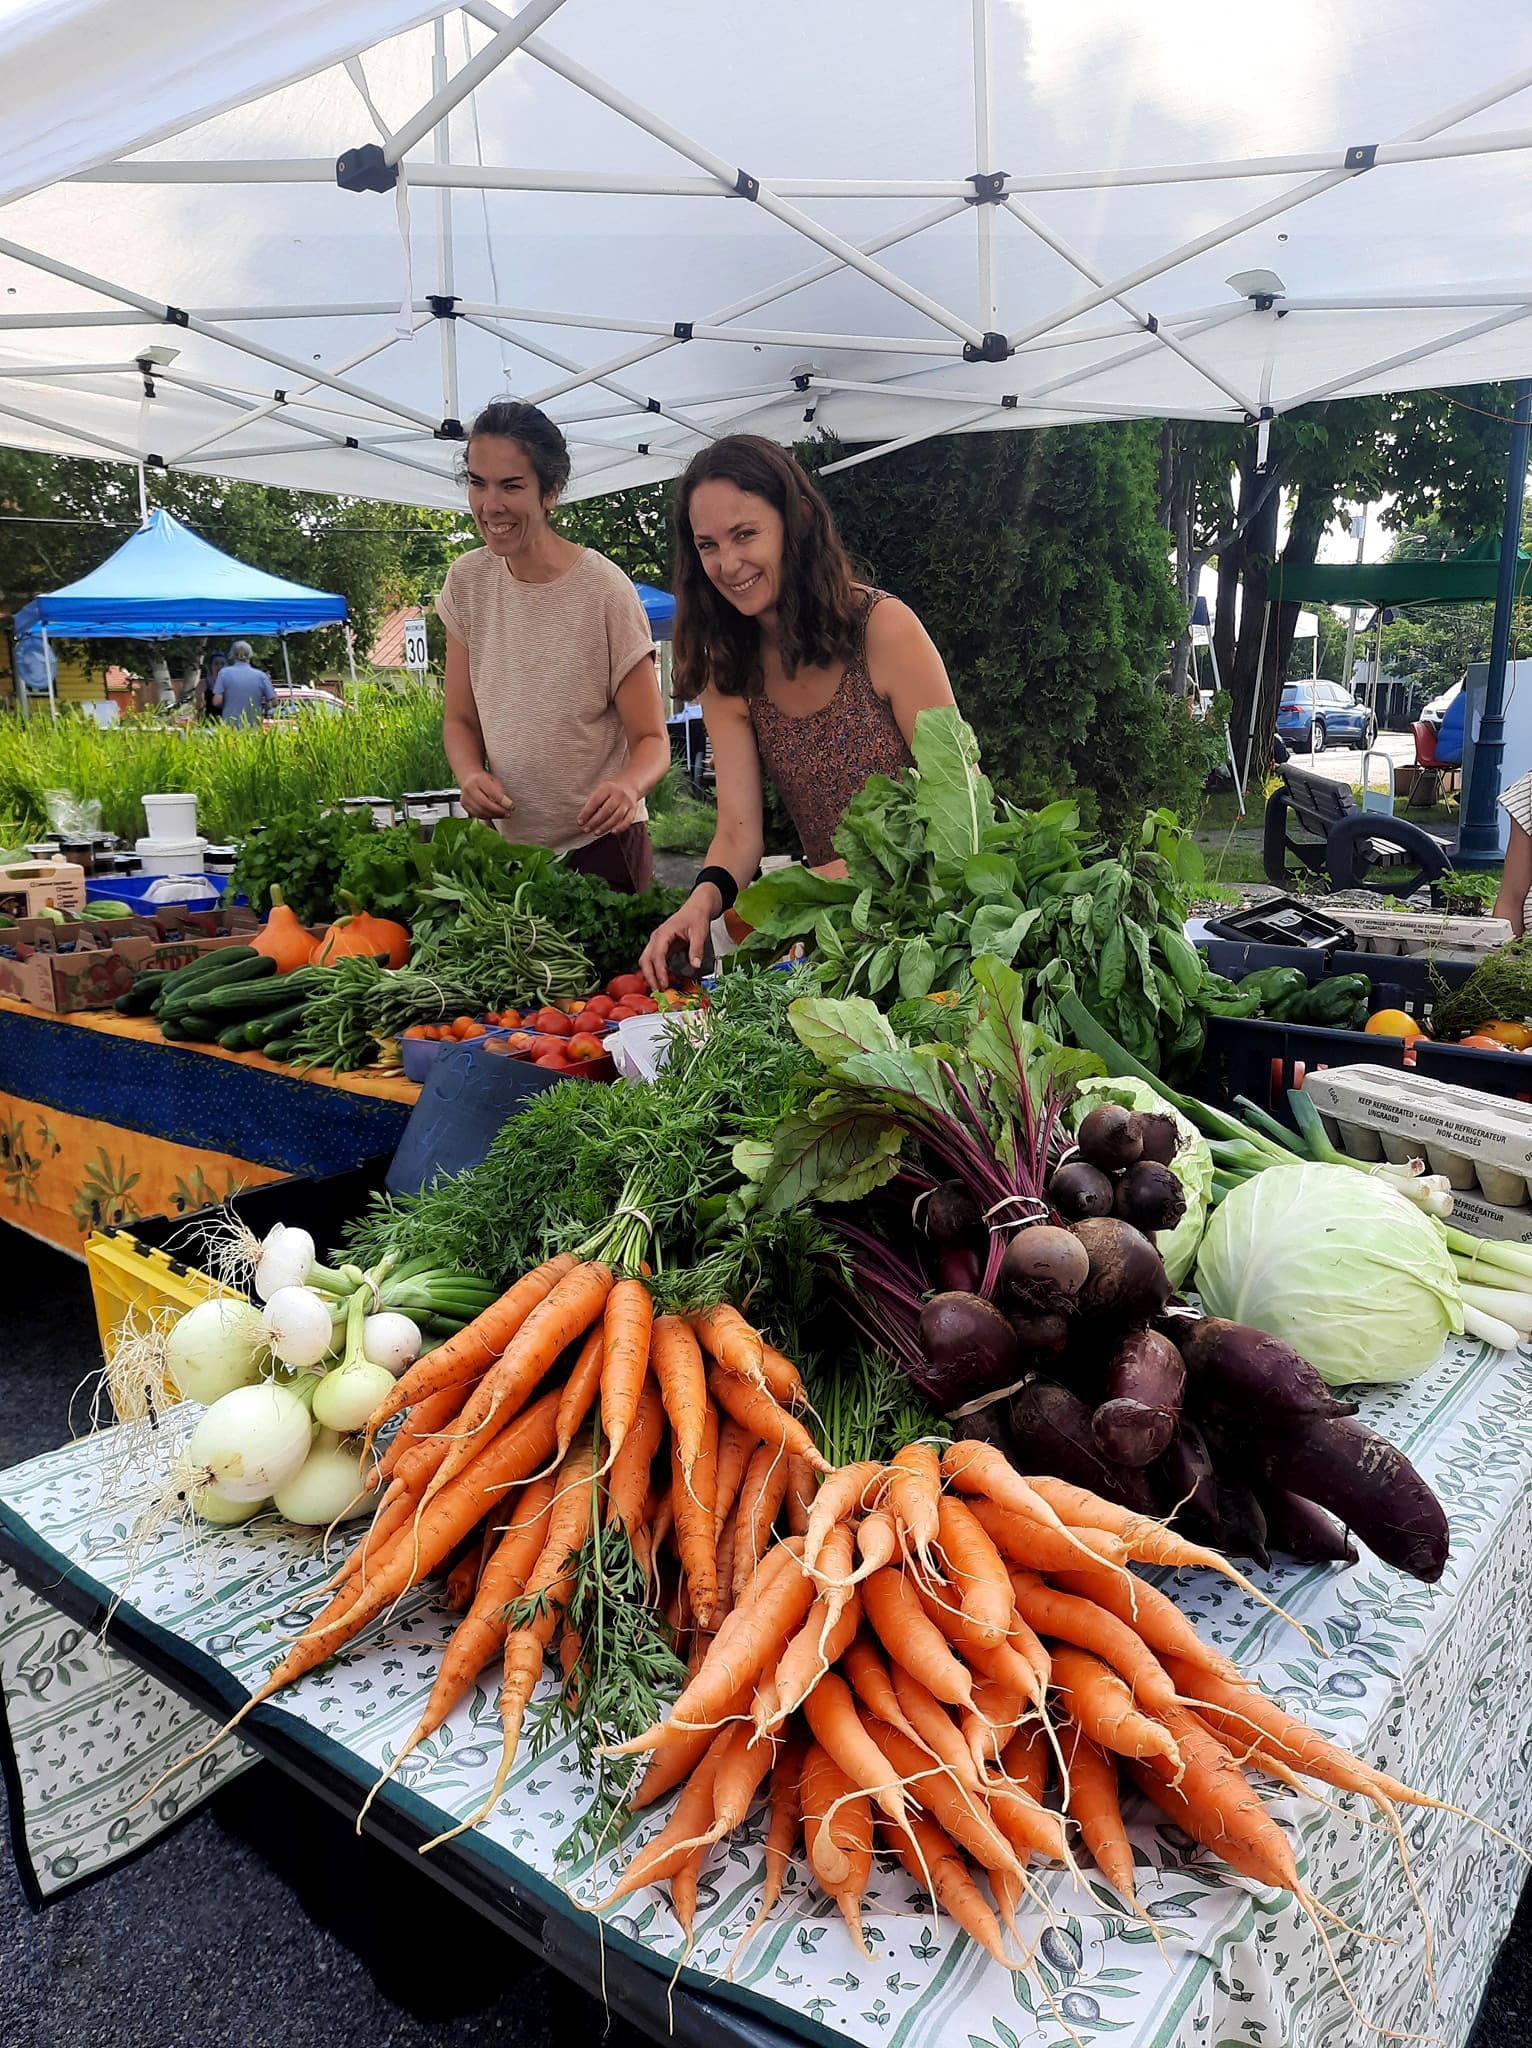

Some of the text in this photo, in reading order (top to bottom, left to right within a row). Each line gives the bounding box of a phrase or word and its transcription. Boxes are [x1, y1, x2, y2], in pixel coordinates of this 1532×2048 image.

[407, 637, 425, 664] 30
[1328, 1087, 1339, 1105] EGGS
[1358, 1096, 1373, 1108] KEEP
[1372, 1100, 1414, 1118] REFRIGERATED
[1419, 1113, 1444, 1127] GARDER
[1444, 1120, 1455, 1130] AU
[1367, 1108, 1482, 1147] UNGRADED NON-CLASSÉS
[1453, 1198, 1505, 1223] RÉFRIGÉRATEUR
